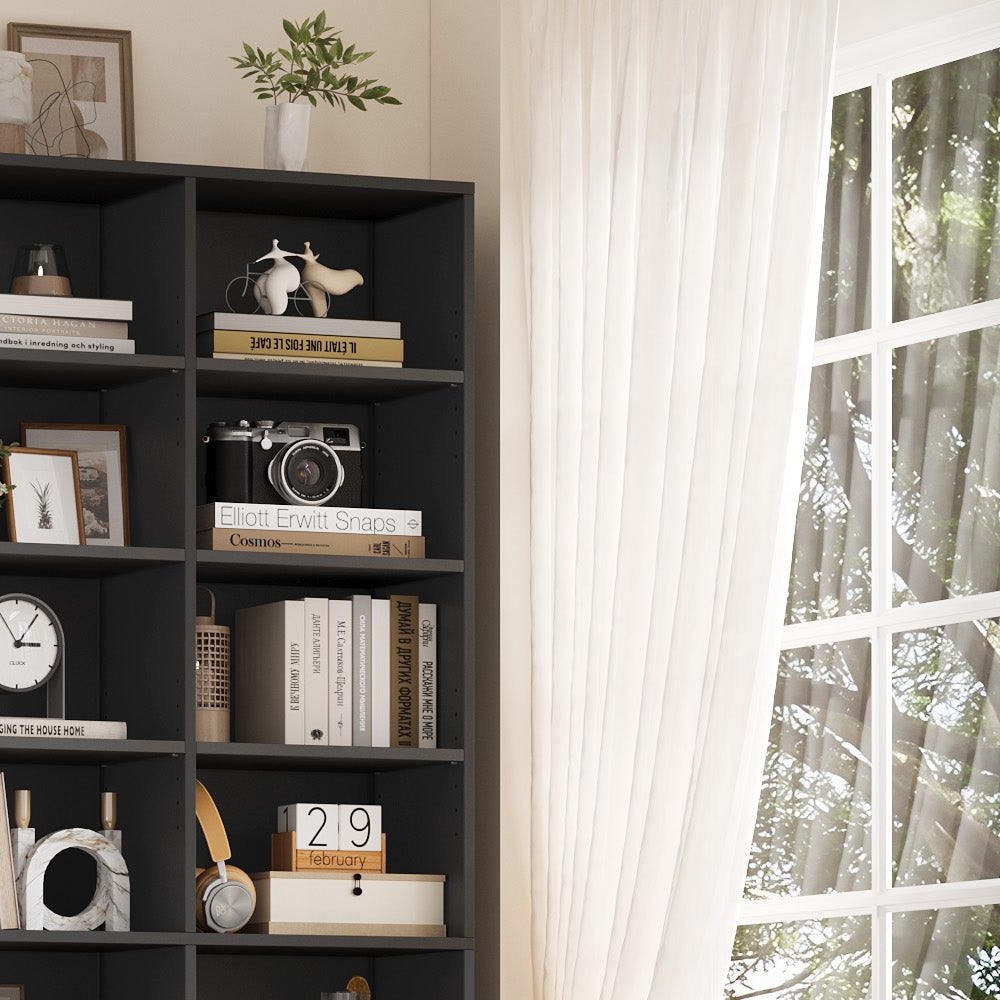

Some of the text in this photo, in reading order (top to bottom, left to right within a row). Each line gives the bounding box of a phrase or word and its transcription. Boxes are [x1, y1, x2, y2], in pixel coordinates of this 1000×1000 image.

[53, 317, 96, 329] HAGAN
[29, 339, 69, 349] inredning
[71, 341, 86, 349] och
[88, 342, 115, 352] styling
[250, 336, 356, 355] IL ÉTAIT UNE FOIS LE CAFÉ
[221, 506, 396, 535] Elliott Erwitt Snaps
[230, 534, 281, 548] Cosmos
[396, 600, 415, 634] ДУМАЙ
[290, 642, 300, 666] МИРУ
[312, 614, 320, 674] ДАНТЕ АЛИГЬЕРИ
[396, 647, 412, 684] ДРУГИХ
[290, 669, 300, 704] ВЕЧНОМУ
[422, 661, 433, 697] РАССКАЖИ
[398, 687, 412, 738] ФОРМАТАХ
[422, 699, 433, 713] МНЕ
[20, 724, 34, 735] THE
[36, 725, 61, 735] HOUSE
[64, 726, 85, 736] HOME
[422, 722, 433, 740] МОРЕ
[309, 851, 366, 870] february
